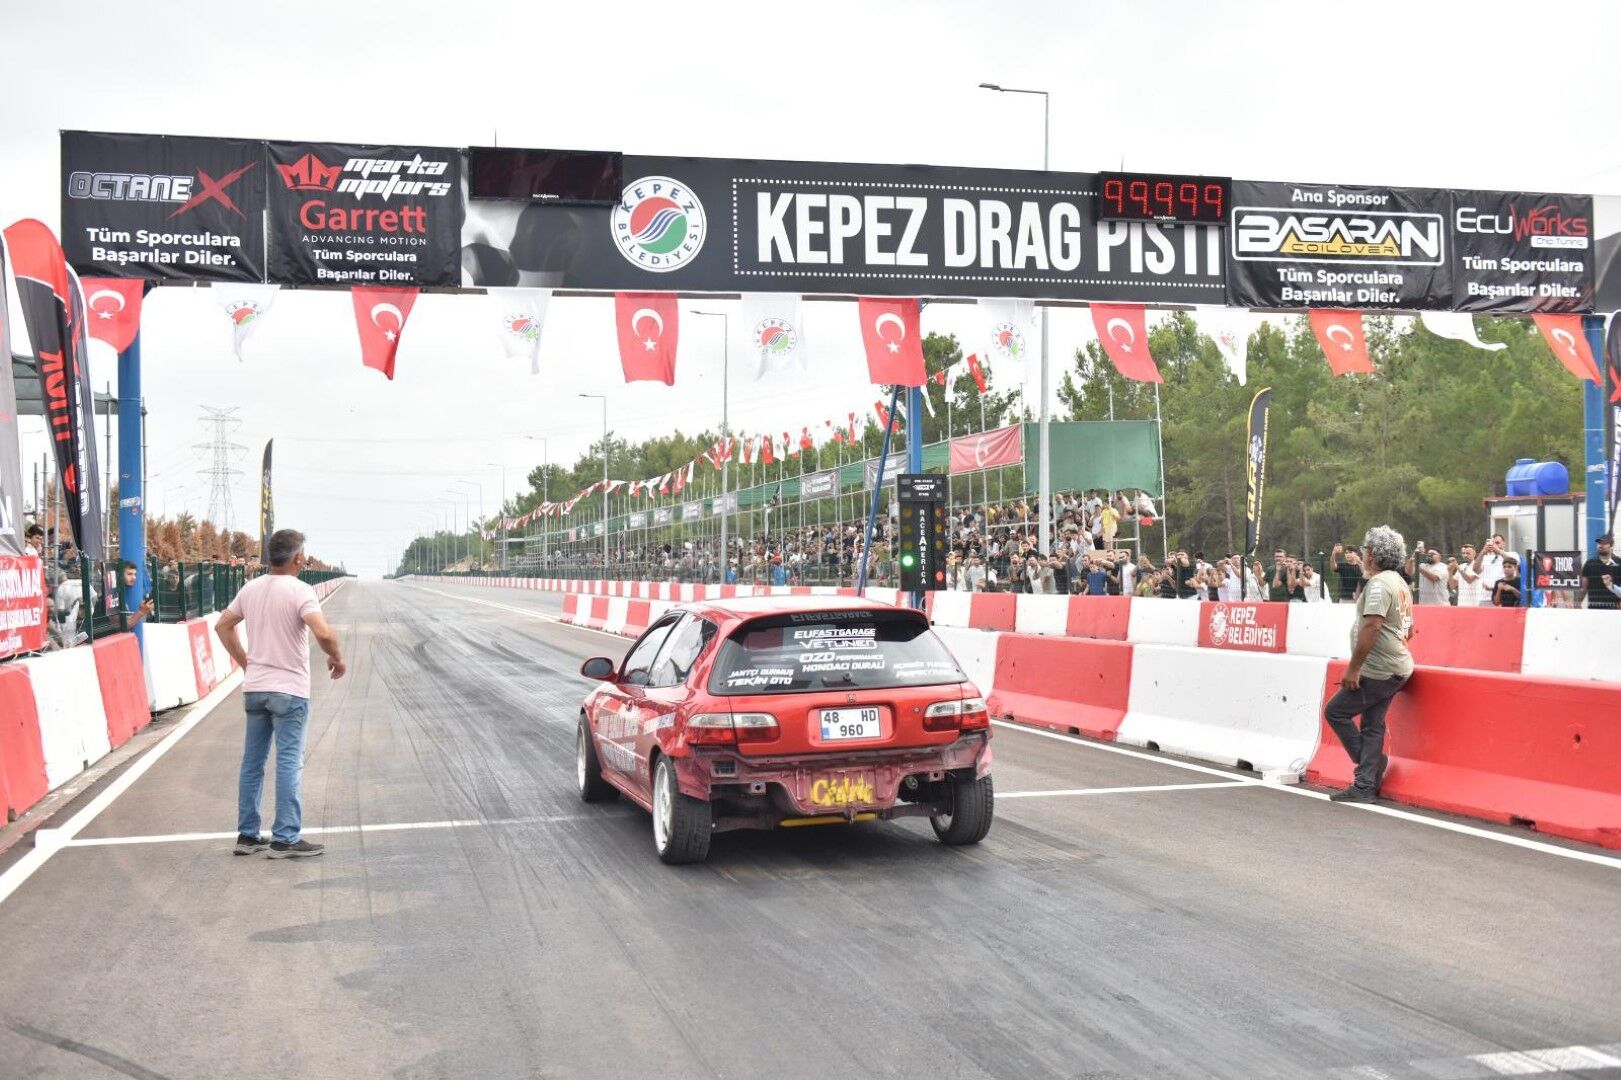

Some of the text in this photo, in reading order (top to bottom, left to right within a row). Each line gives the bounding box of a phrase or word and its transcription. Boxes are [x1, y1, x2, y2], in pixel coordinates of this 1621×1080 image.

[622, 183, 696, 213] KEPEZ
[1104, 180, 1223, 219] 99.999
[1291, 189, 1389, 207] Ana Sponsor
[300, 199, 426, 233] Garrett
[86, 227, 241, 247] Tüm Sporculara
[302, 235, 427, 246] ADVANCING MOTION
[757, 191, 929, 267] KEPEZ
[943, 197, 1082, 272] DRAG
[92, 246, 237, 266] Başarılar Diler.
[313, 250, 417, 263] Tüm Sporculara
[1462, 256, 1584, 274] Tüm Sporculara
[317, 268, 414, 282] Başarılar Diler.
[1277, 268, 1404, 285] Tüm Sporculara
[1281, 287, 1400, 305] Başarılar Diler.
[1467, 282, 1581, 300] Başarılar Diler.
[1554, 556, 1573, 572] THOR
[1229, 606, 1257, 626] KEPEZ
[824, 705, 877, 724] 48 HD
[840, 724, 864, 737] 960
